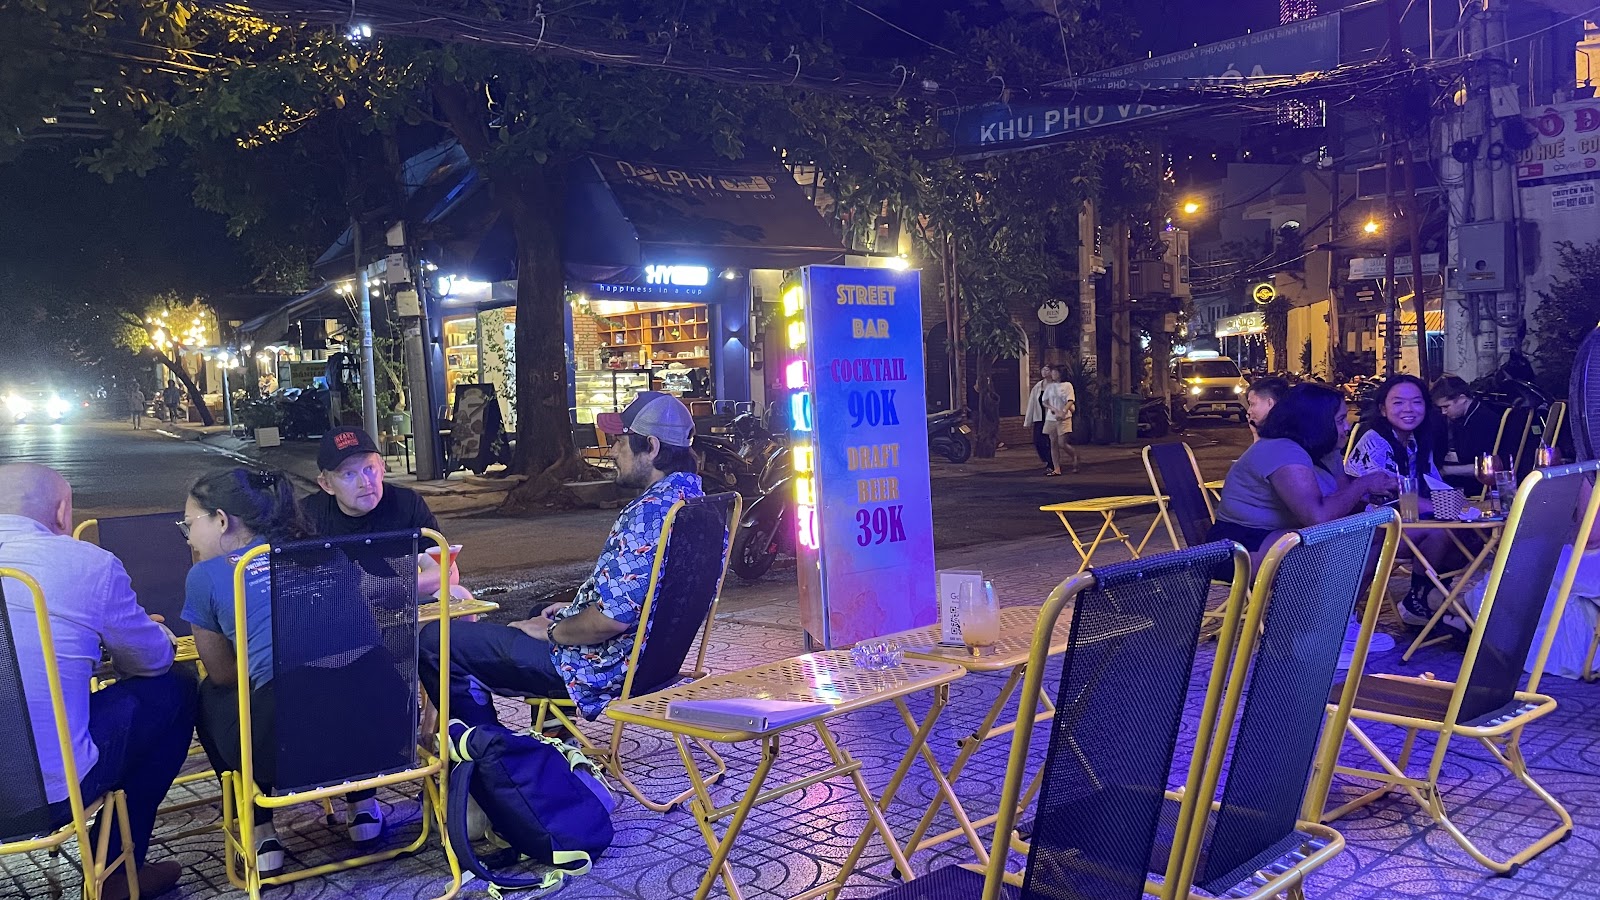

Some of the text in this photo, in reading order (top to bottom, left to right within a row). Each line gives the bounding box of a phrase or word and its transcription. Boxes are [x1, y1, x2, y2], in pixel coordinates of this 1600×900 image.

[980, 115, 1033, 143] KHU
[600, 284, 652, 293] happiness
[686, 288, 703, 296] cup
[836, 284, 896, 306] STREET
[852, 318, 890, 339] BAR
[831, 358, 907, 383] COCKTAIL
[848, 389, 900, 428] 90K
[847, 443, 900, 471] DRAFT
[857, 476, 900, 505] BEER
[856, 505, 907, 547] 39K
